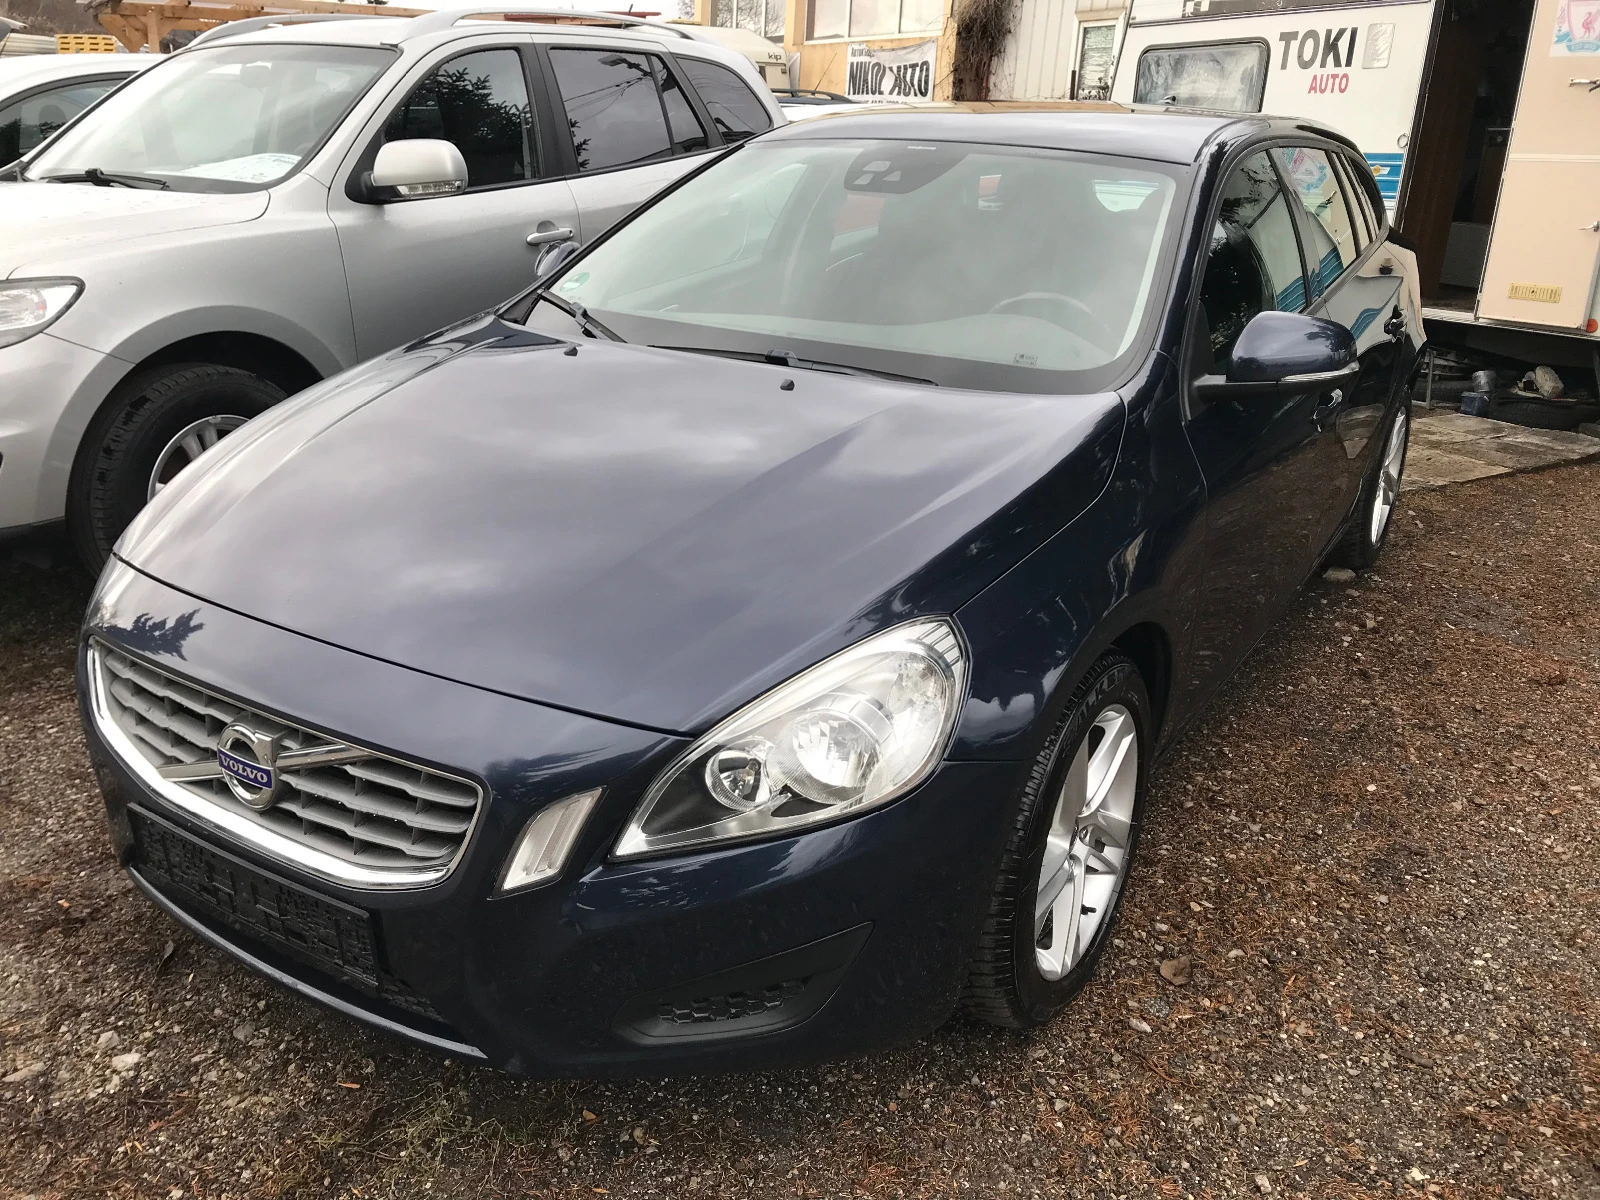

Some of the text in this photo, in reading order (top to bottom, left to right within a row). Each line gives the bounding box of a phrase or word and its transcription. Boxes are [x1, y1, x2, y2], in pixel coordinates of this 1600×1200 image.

[767, 52, 782, 62] kip
[1279, 27, 1359, 70] TOKI
[847, 60, 930, 97] NIKOL AUTO
[1308, 72, 1350, 95] AUTO
[219, 753, 268, 783] VOLVO
